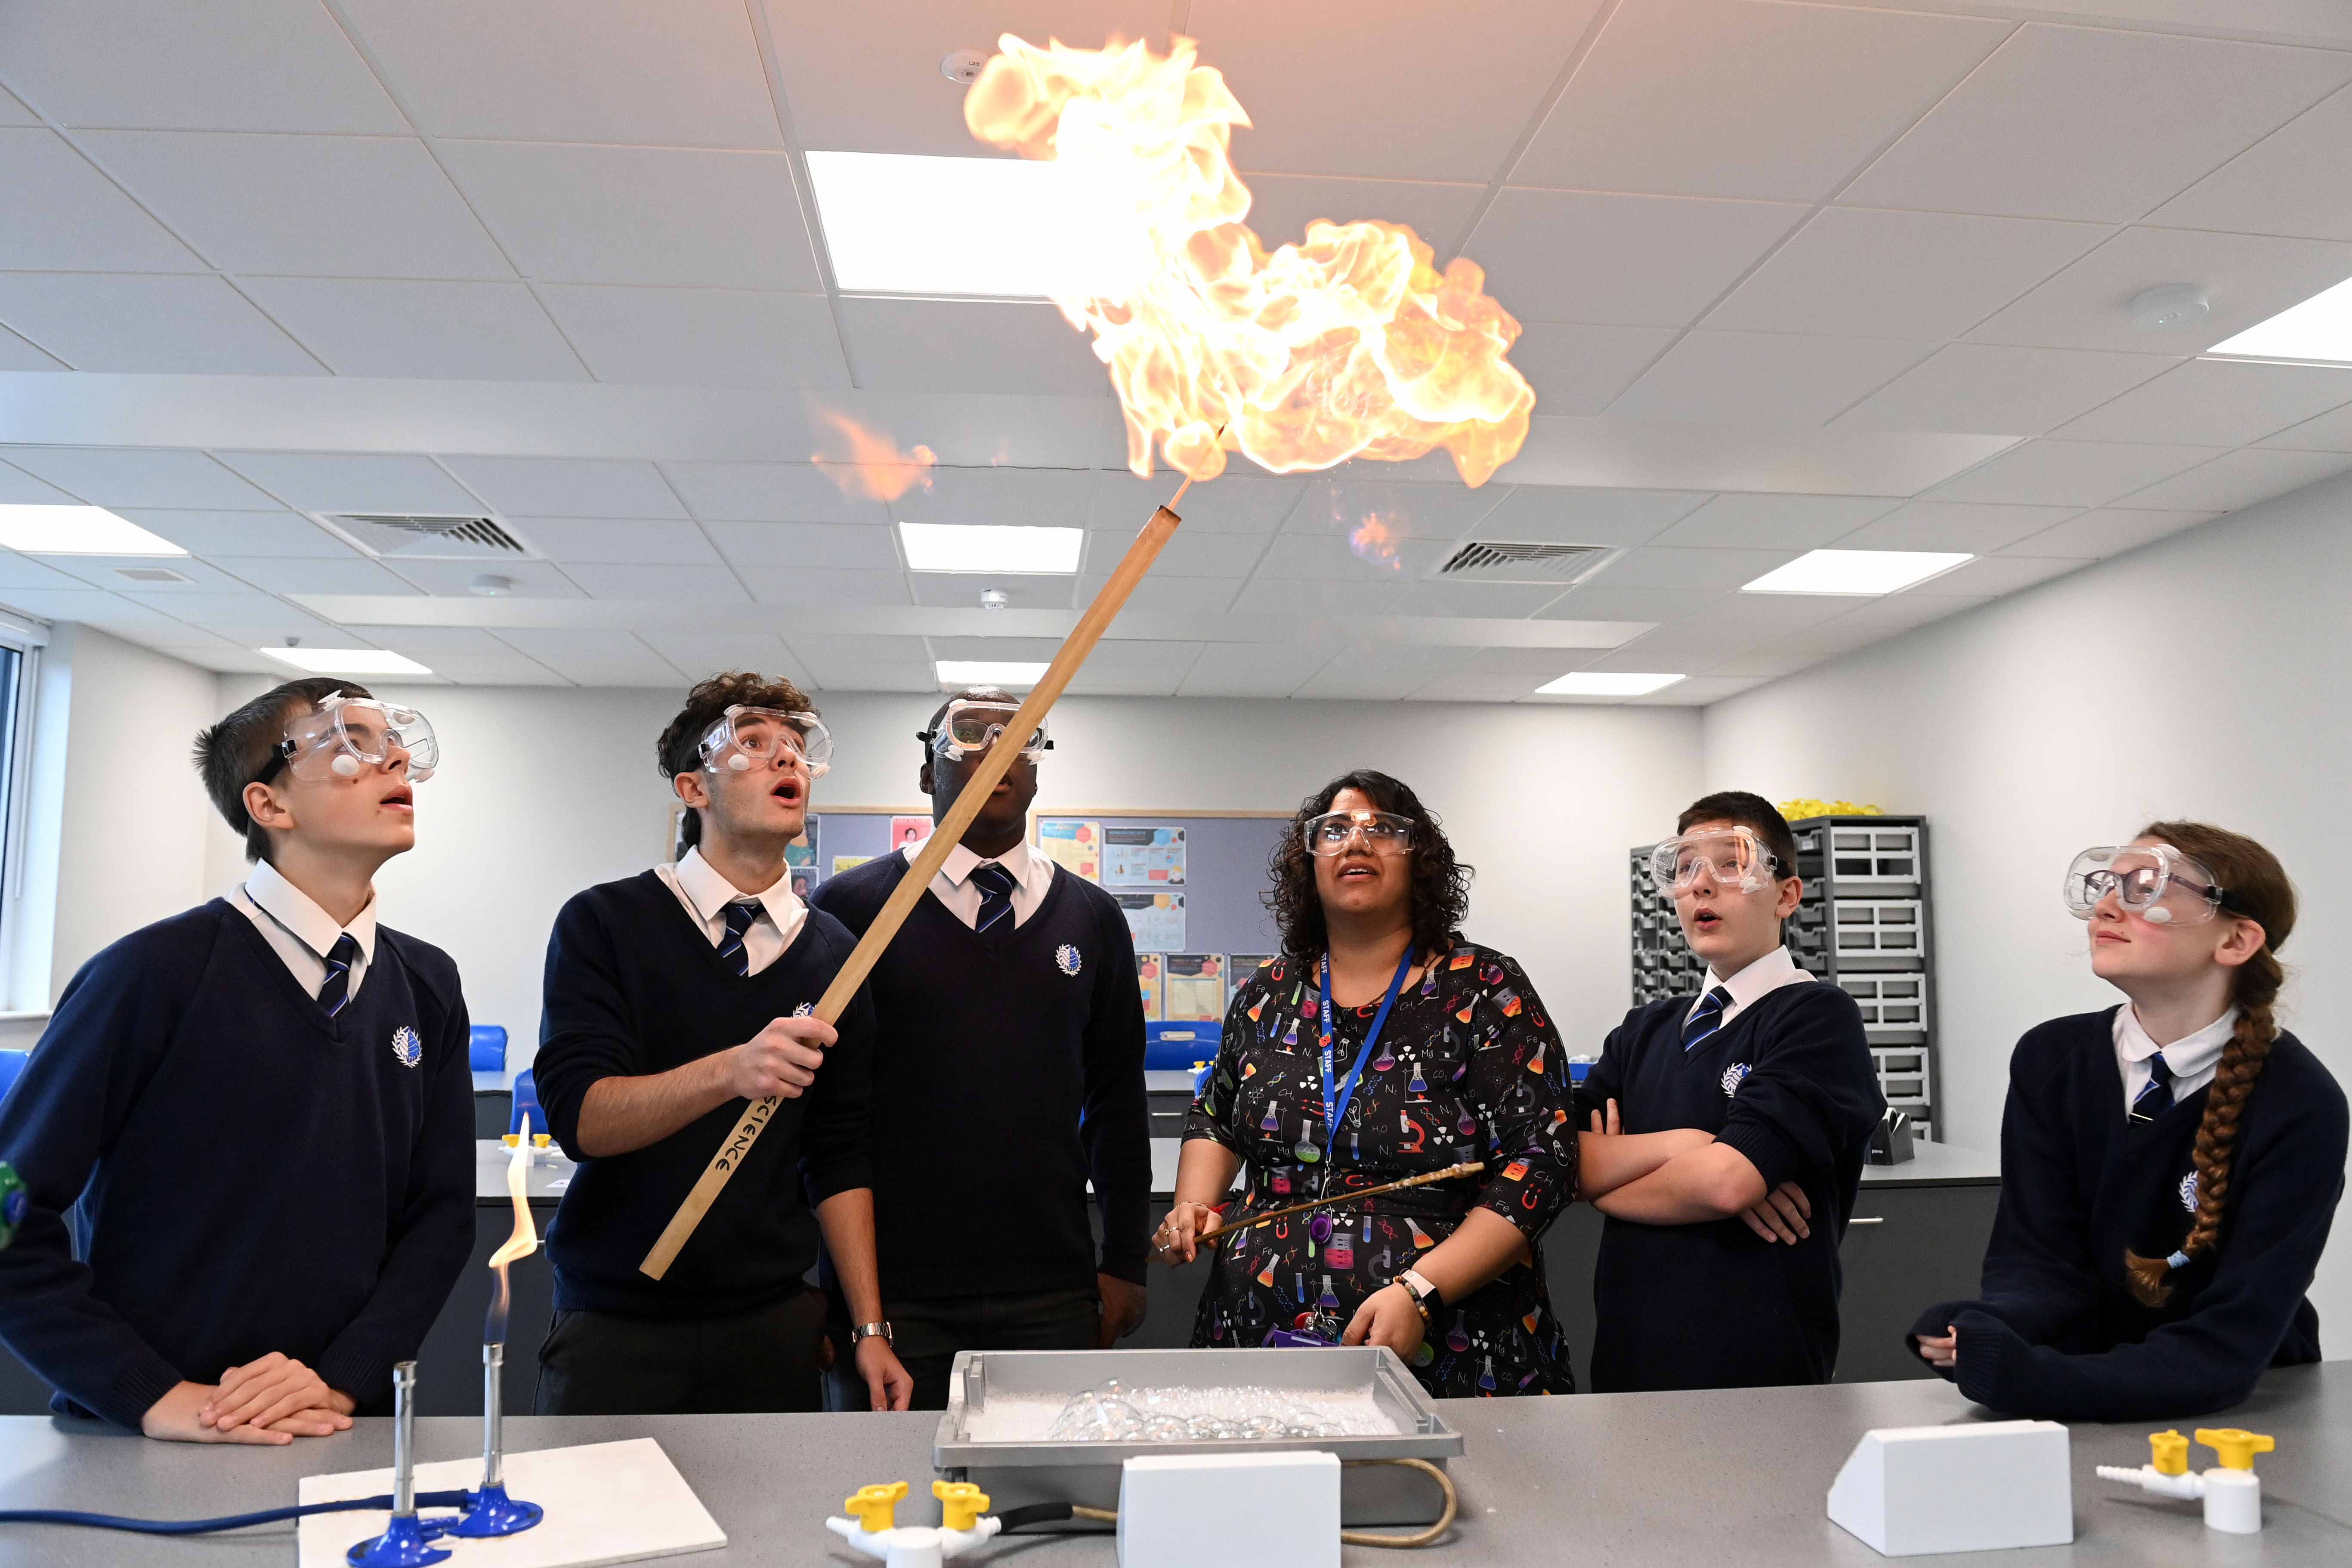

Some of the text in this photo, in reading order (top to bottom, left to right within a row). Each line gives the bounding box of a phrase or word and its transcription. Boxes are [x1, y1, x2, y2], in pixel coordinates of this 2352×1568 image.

[1255, 984, 1266, 993] Fe
[1462, 987, 1475, 996] Fe
[1526, 1034, 1538, 1045] Fe
[1422, 1048, 1434, 1059] Mg
[1278, 1089, 1295, 1101] CH4
[1385, 1083, 1397, 1095] N2
[1326, 1101, 1334, 1129] STAFF
[1439, 1104, 1453, 1116] N2
[1494, 1104, 1507, 1115] Mg
[715, 1096, 777, 1172] SCIENCE
[1277, 1146, 1291, 1157] Mg
[1496, 1200, 1510, 1212] Fe
[1262, 1247, 1273, 1256] Fe
[1234, 1314, 1243, 1326] Mg
[1494, 1343, 1505, 1357] Mg
